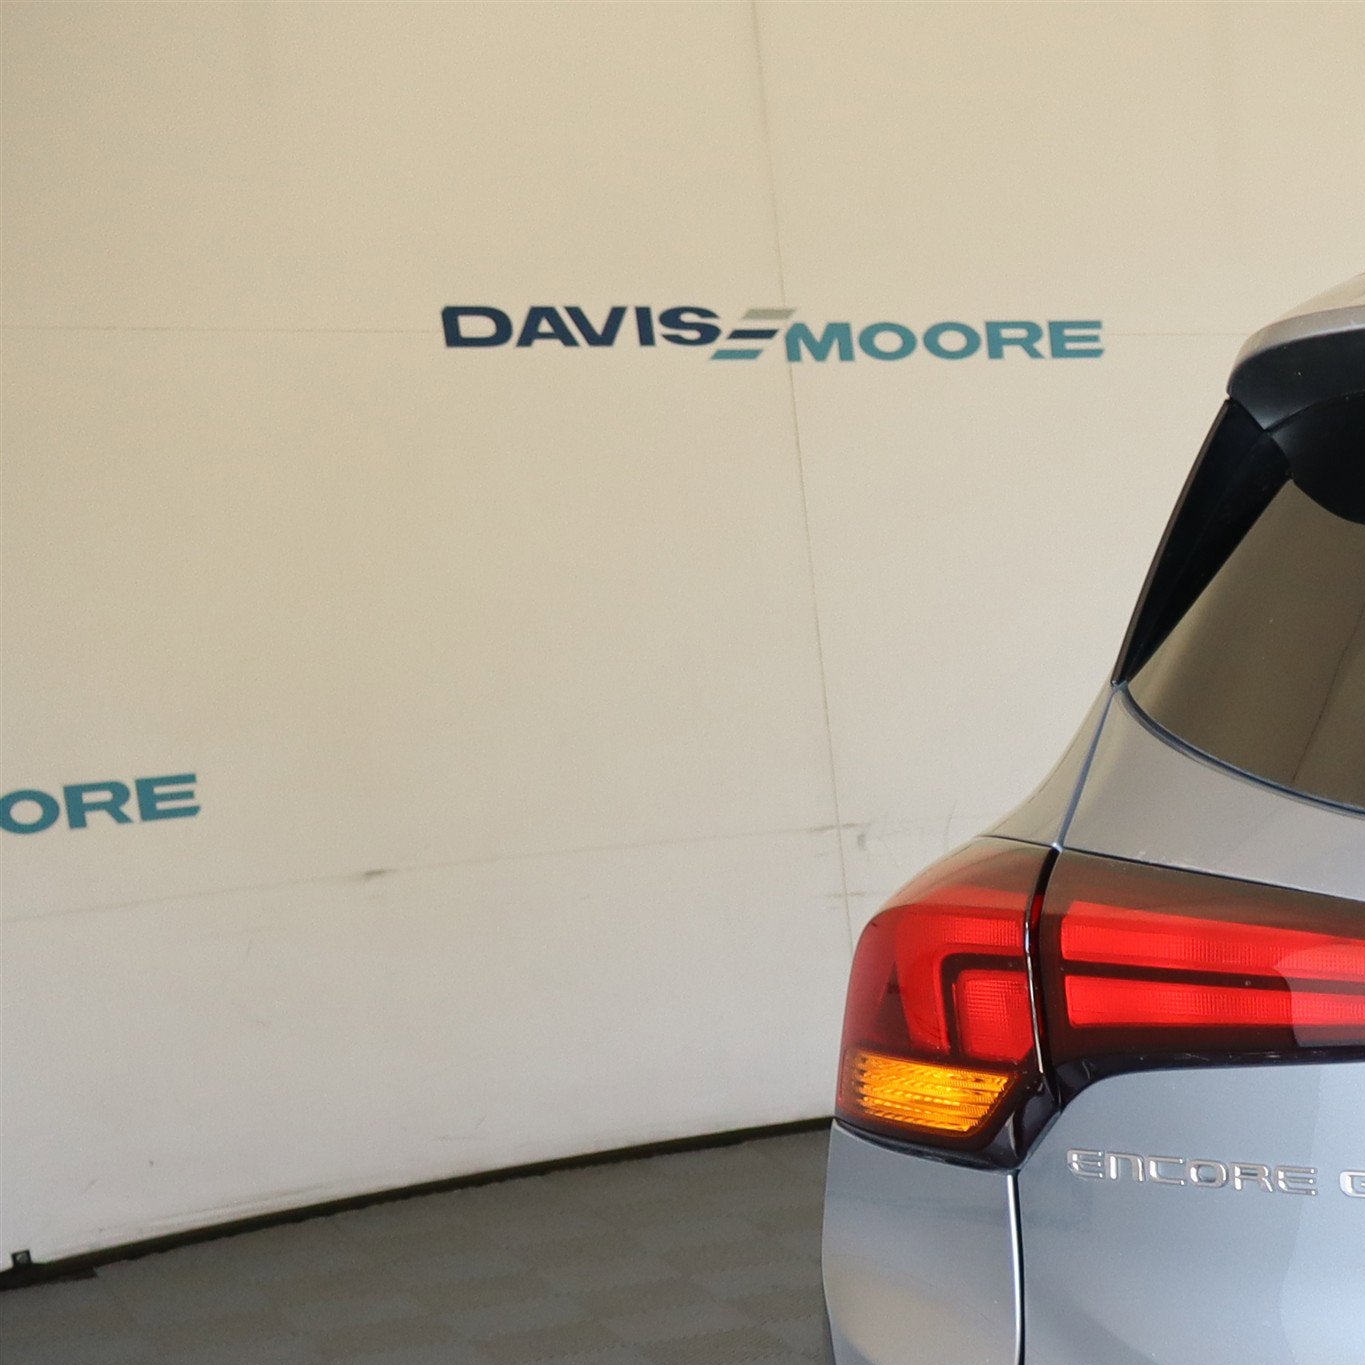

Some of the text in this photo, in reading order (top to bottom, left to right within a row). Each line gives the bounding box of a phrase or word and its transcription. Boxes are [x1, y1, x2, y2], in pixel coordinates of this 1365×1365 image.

[440, 305, 1105, 362] DAVIS MOORE
[1067, 1148, 1318, 1196] ENCORE
